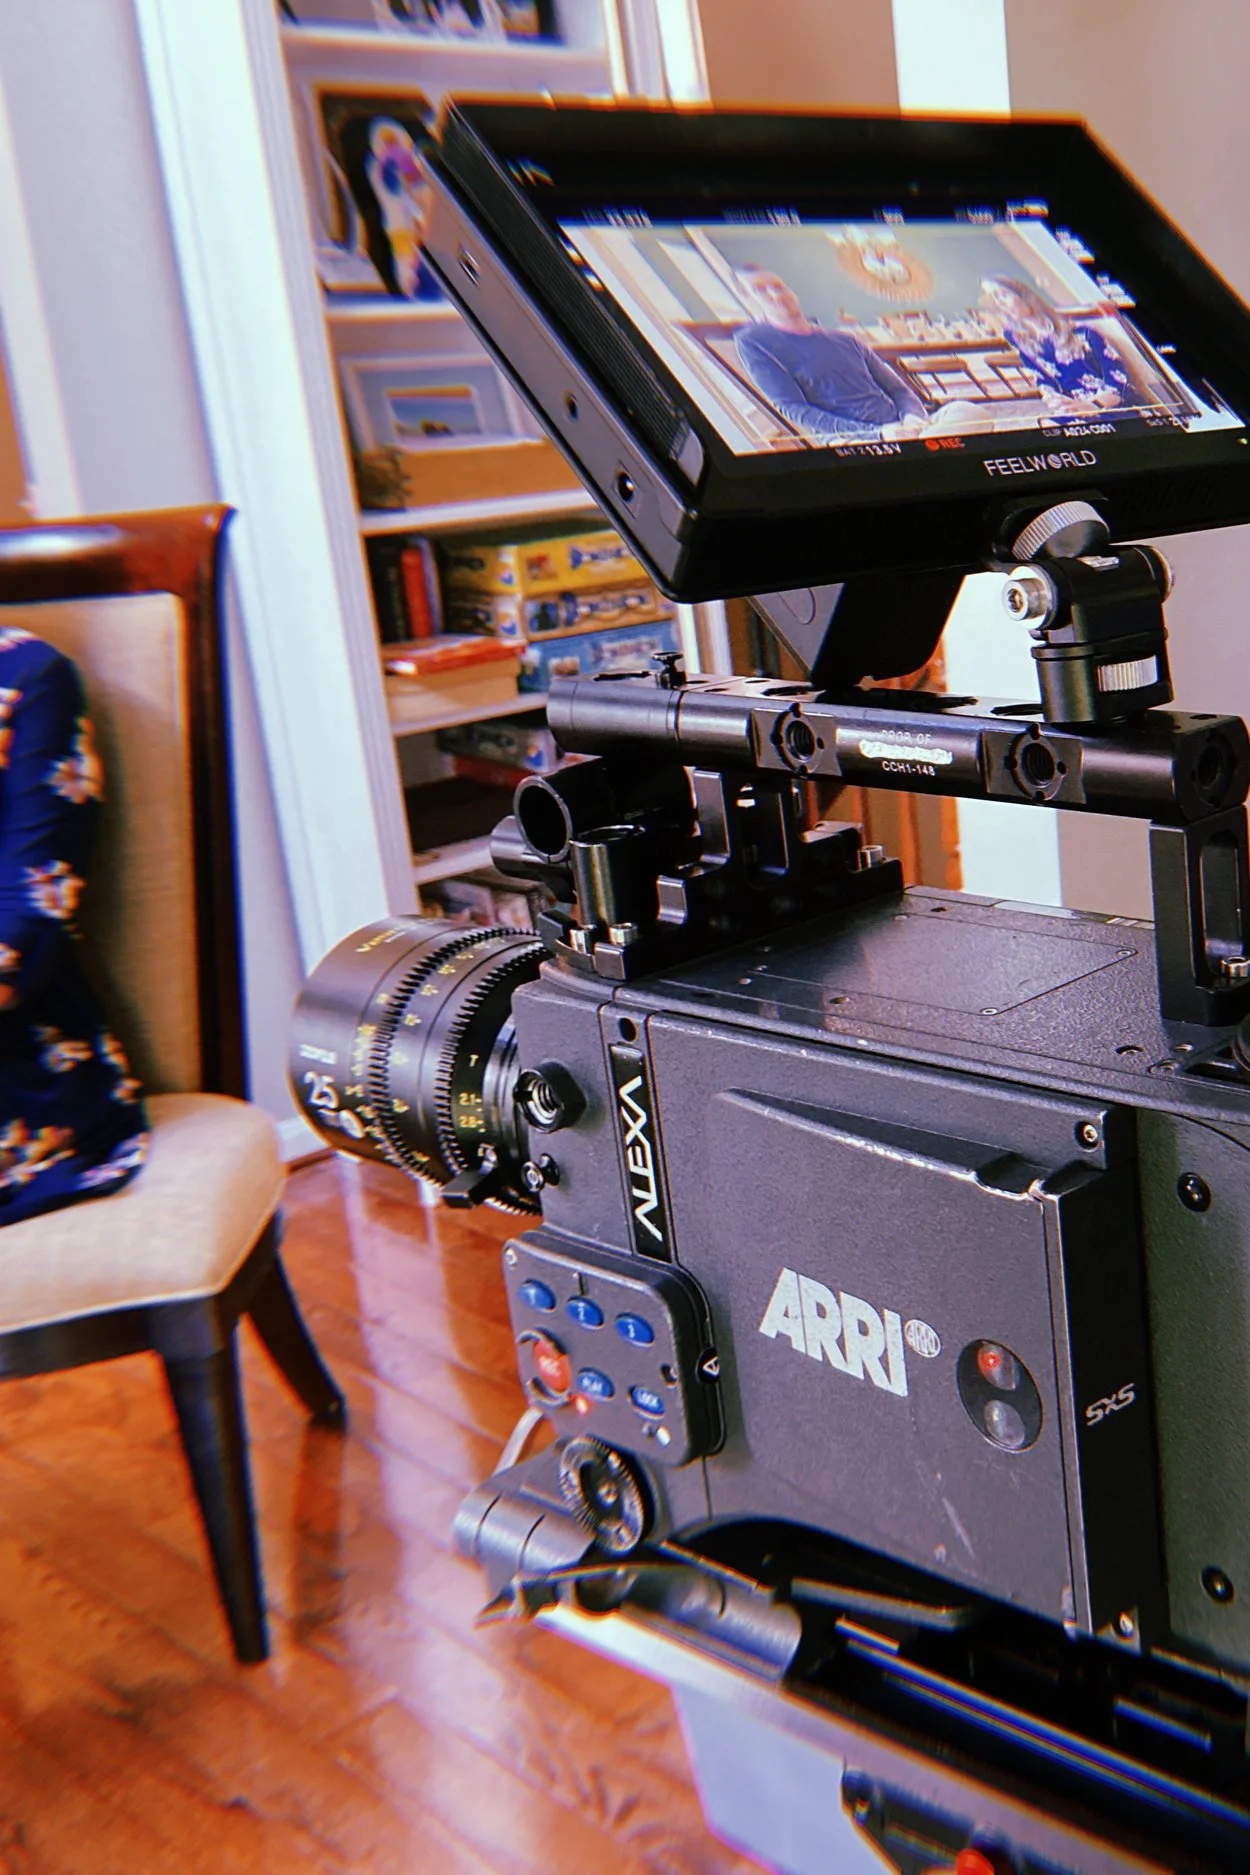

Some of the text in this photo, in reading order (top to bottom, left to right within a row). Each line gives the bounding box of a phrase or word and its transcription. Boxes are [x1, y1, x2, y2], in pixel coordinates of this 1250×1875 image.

[939, 437, 965, 450] REC
[983, 450, 1097, 476] FEELWORLD
[916, 732, 932, 745] OF
[881, 760, 936, 777] CCH1-148
[302, 1070, 340, 1110] 25
[618, 1075, 663, 1242] ALEXA
[759, 1267, 908, 1397] ARRI
